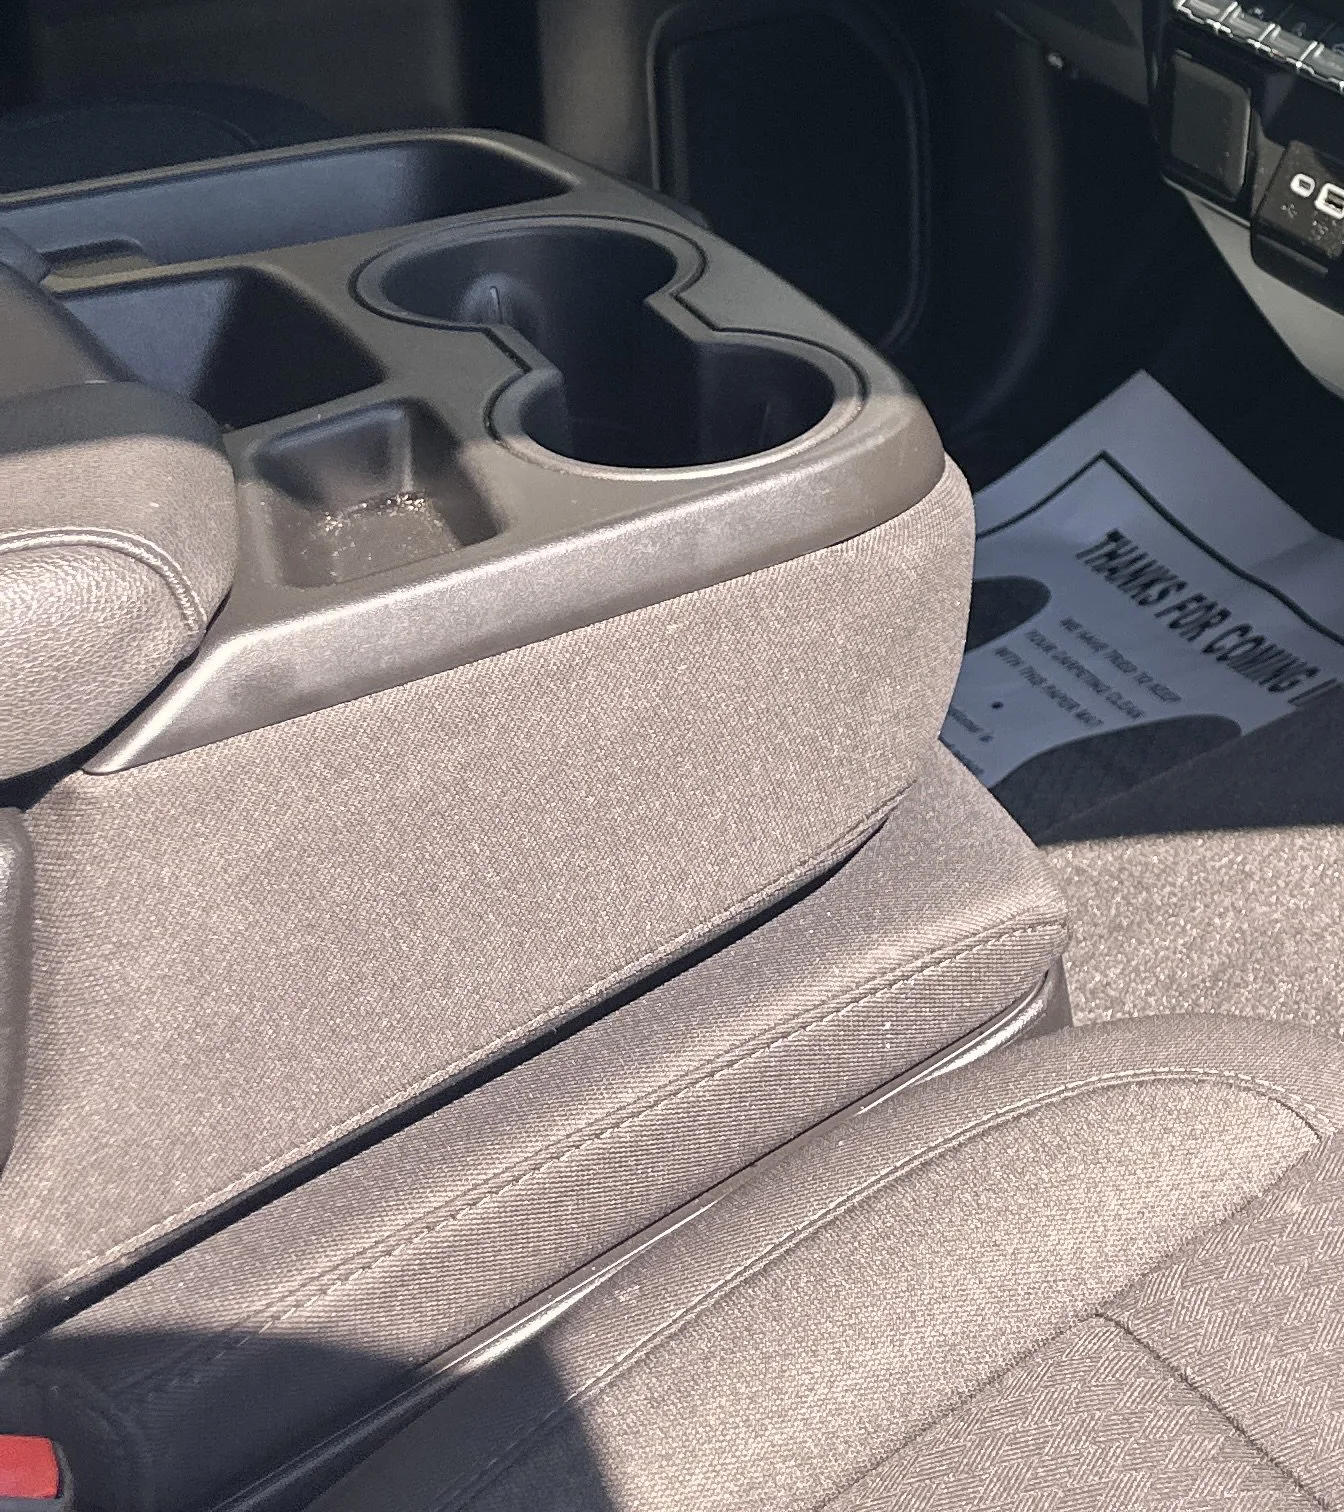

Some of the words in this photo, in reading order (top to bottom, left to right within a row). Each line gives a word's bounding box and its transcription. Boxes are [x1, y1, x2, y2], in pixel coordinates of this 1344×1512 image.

[1075, 527, 1189, 607] THANKS
[1153, 591, 1232, 643] FOR
[1201, 622, 1321, 693] COMING
